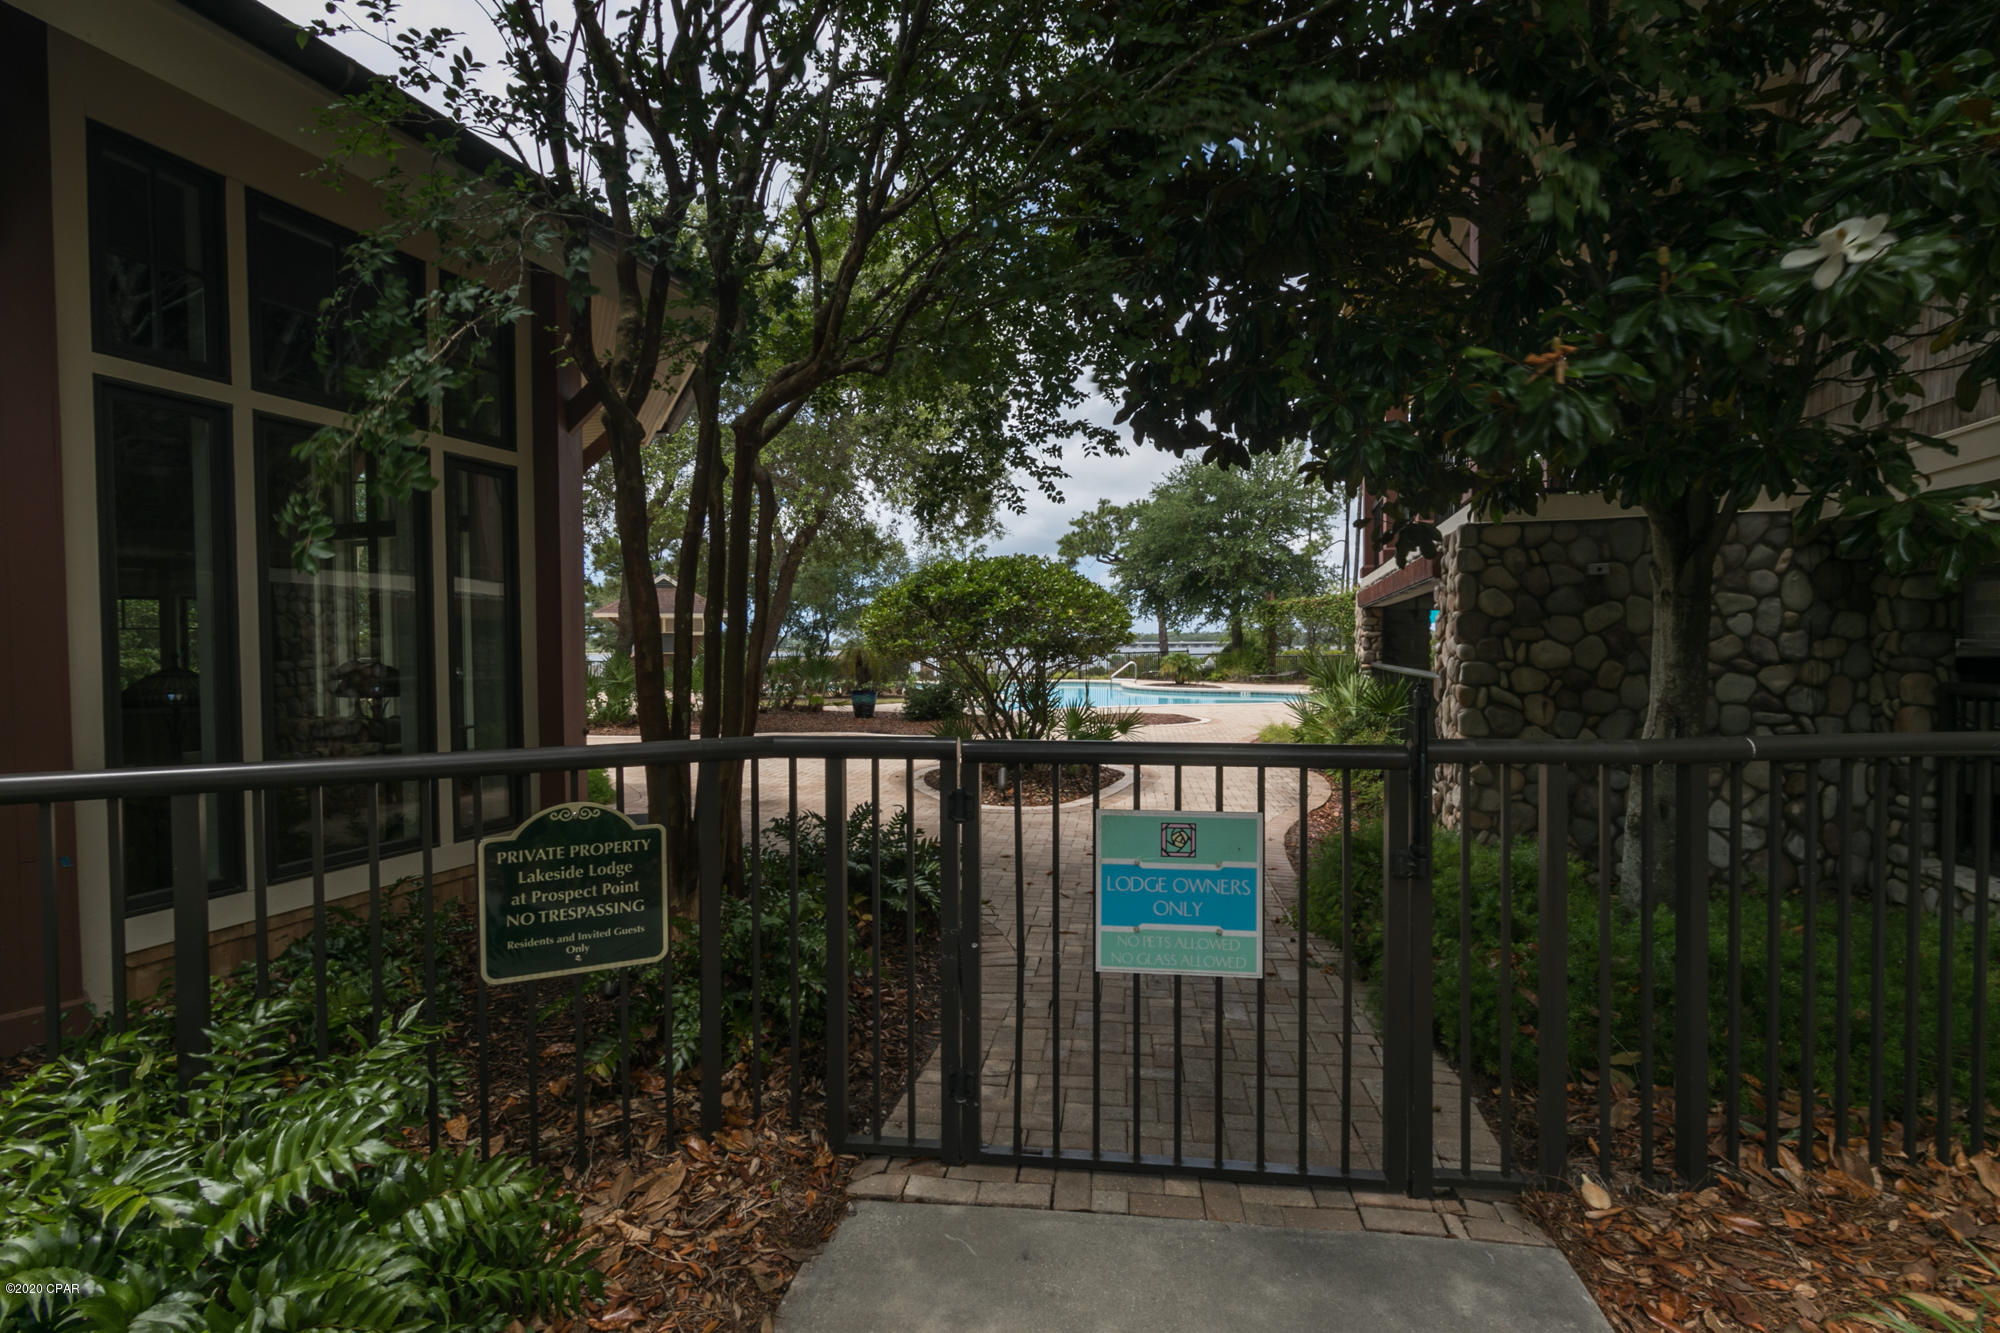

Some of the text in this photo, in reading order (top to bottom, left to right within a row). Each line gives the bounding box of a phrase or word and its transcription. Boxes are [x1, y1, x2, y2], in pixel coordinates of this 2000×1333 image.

[497, 839, 651, 865] PRIVATE PROPERTY
[518, 861, 633, 884] Lakeside Lodge
[511, 880, 640, 906] at Prospect Point
[1106, 875, 1251, 896] LODGE OWNERS
[506, 899, 646, 928] NO TRESPASSING
[1152, 900, 1203, 917] ONLY
[507, 925, 646, 951] Residents and Invited Guests
[565, 943, 590, 955] Only
[1116, 935, 1241, 951] NO PETS ALLOWED
[1110, 951, 1247, 969] NO GLASS ALLOWED
